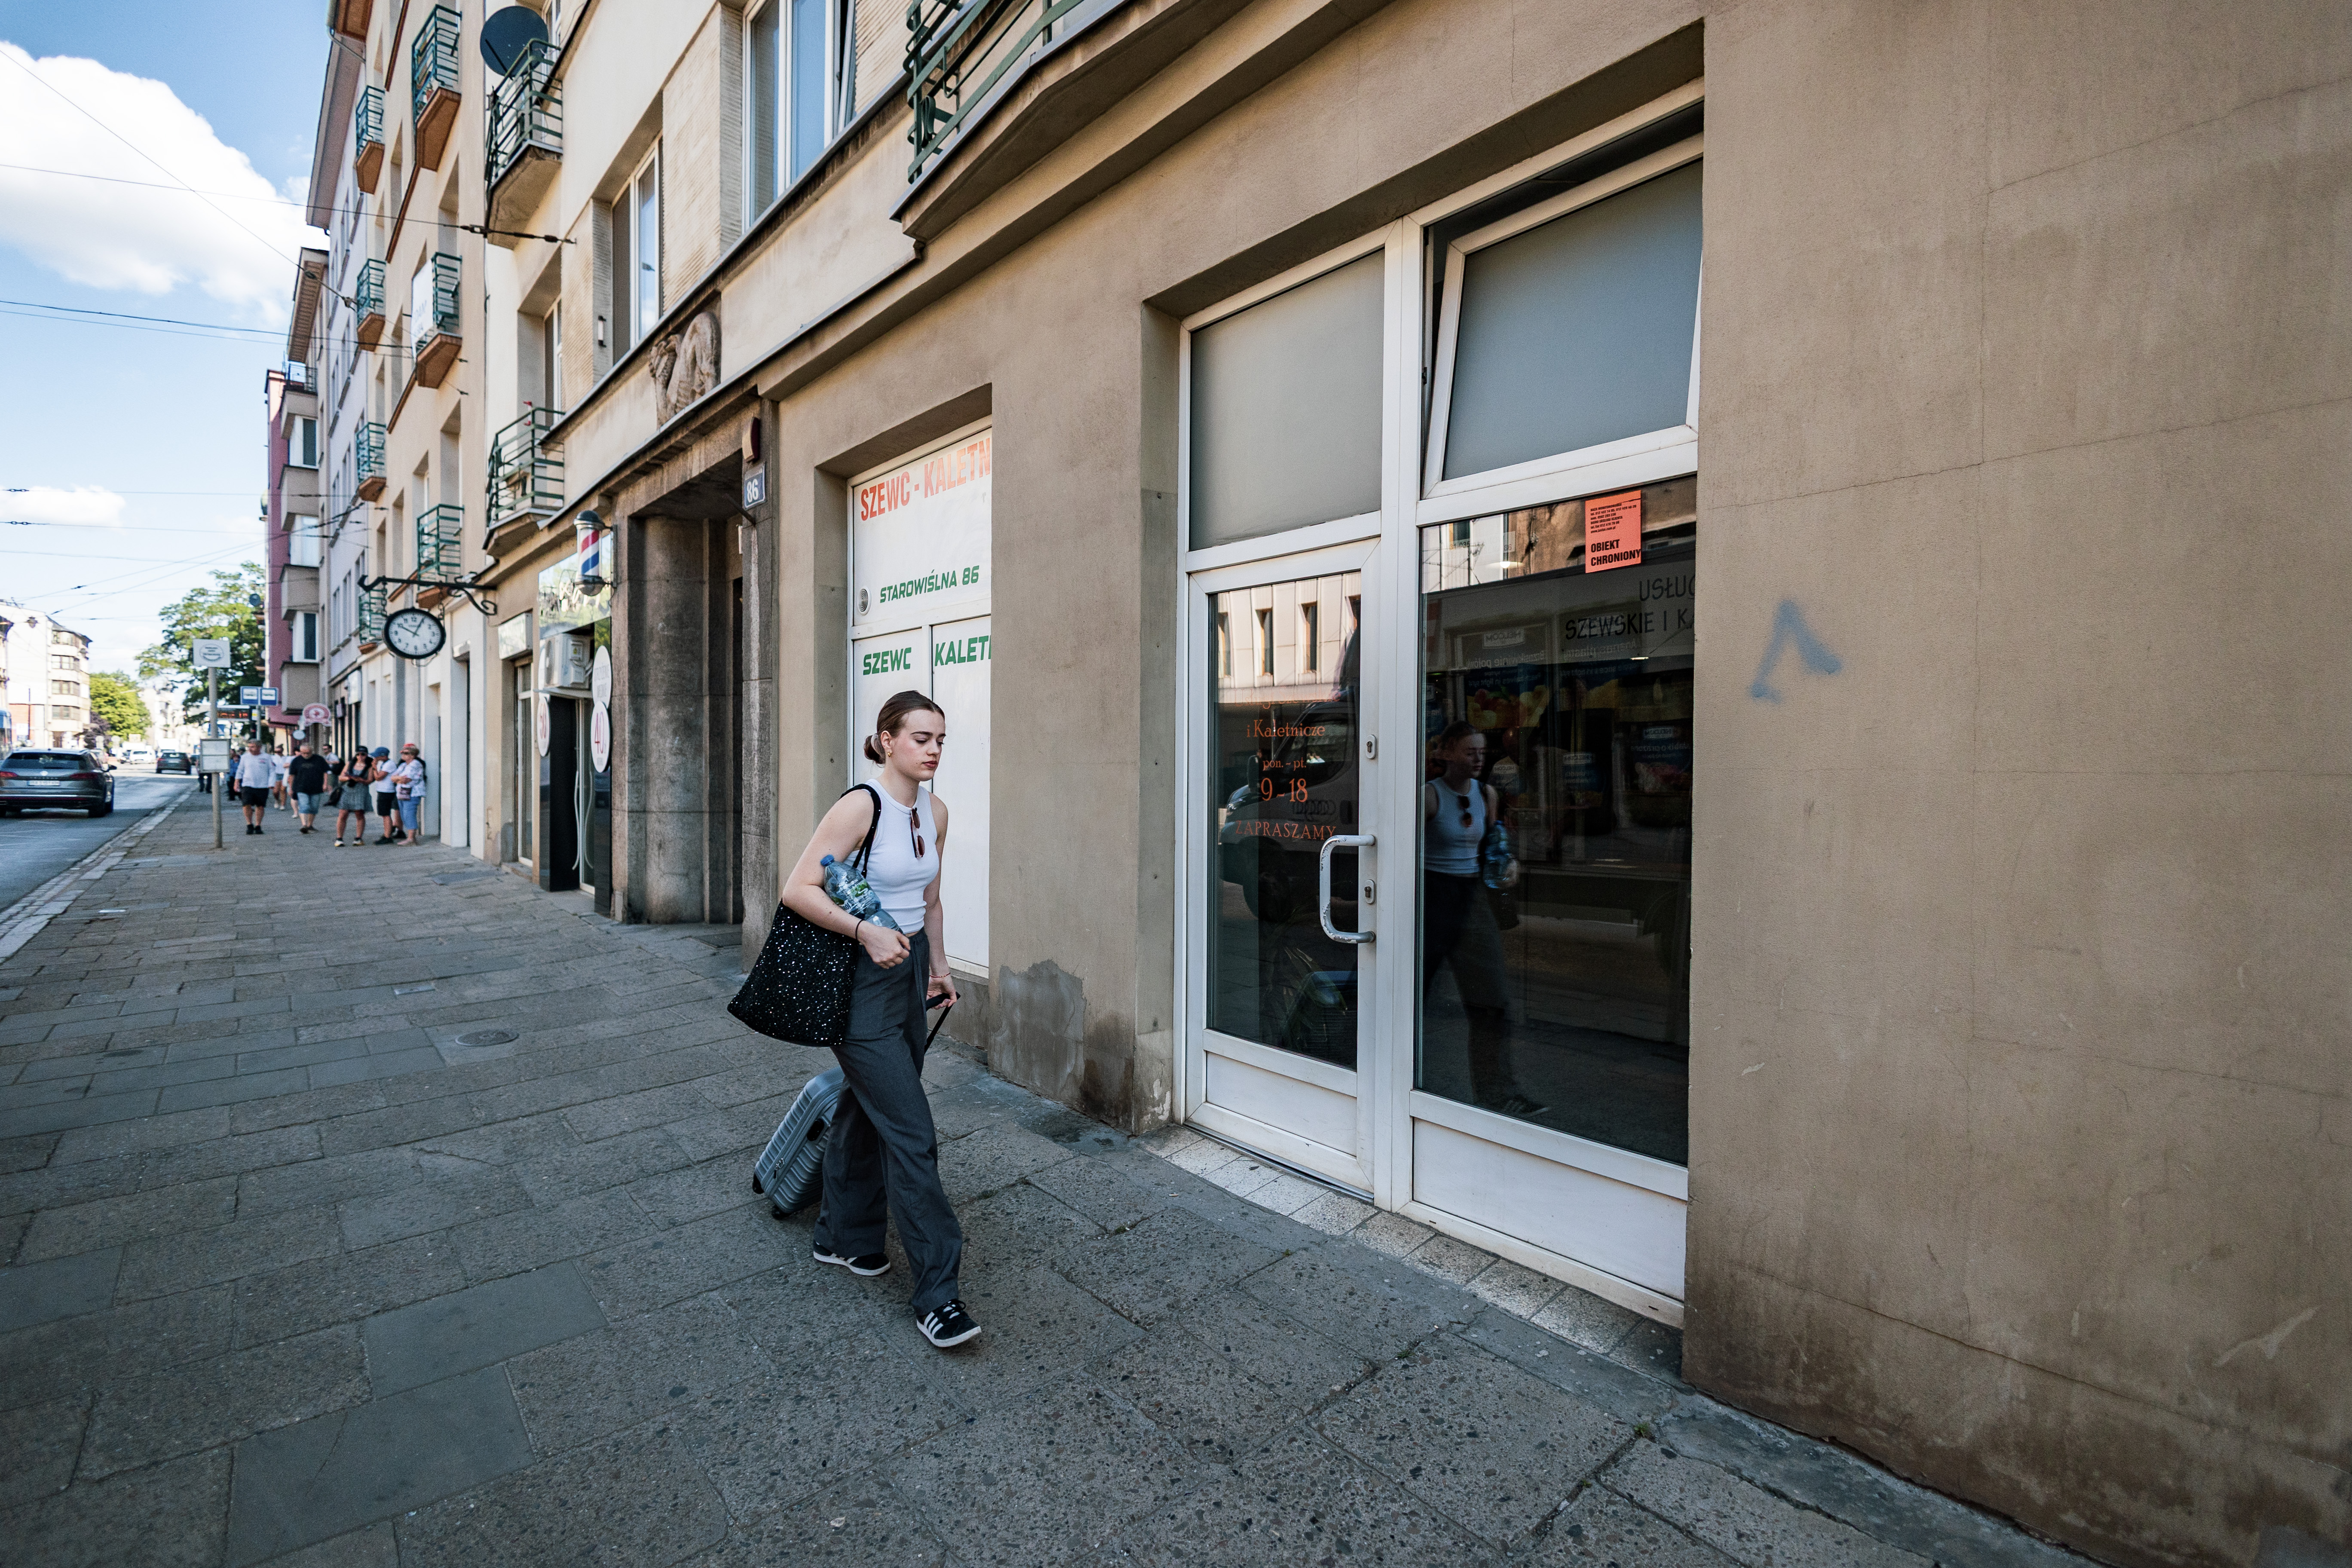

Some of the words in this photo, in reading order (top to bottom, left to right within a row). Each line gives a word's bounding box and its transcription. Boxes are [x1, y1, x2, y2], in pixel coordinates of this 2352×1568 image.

[747, 478, 759, 503] 86
[861, 472, 910, 521] SZEWC
[1591, 539, 1620, 553] OBIEKT
[1591, 548, 1641, 567] CHRONIONY
[880, 569, 957, 603] STAROWIŚLNA
[962, 565, 980, 585] 86
[1565, 612, 1655, 640] SZEWSKIE
[1663, 610, 1667, 631] I
[863, 647, 912, 675] SZEWC
[934, 635, 991, 666] KALET
[1247, 725, 1250, 738] i
[1253, 719, 1326, 737] Kaletnicze
[1263, 760, 1283, 771] pon.
[1294, 757, 1307, 771] pt.
[1235, 820, 1337, 840] ZAPRASZAMY
